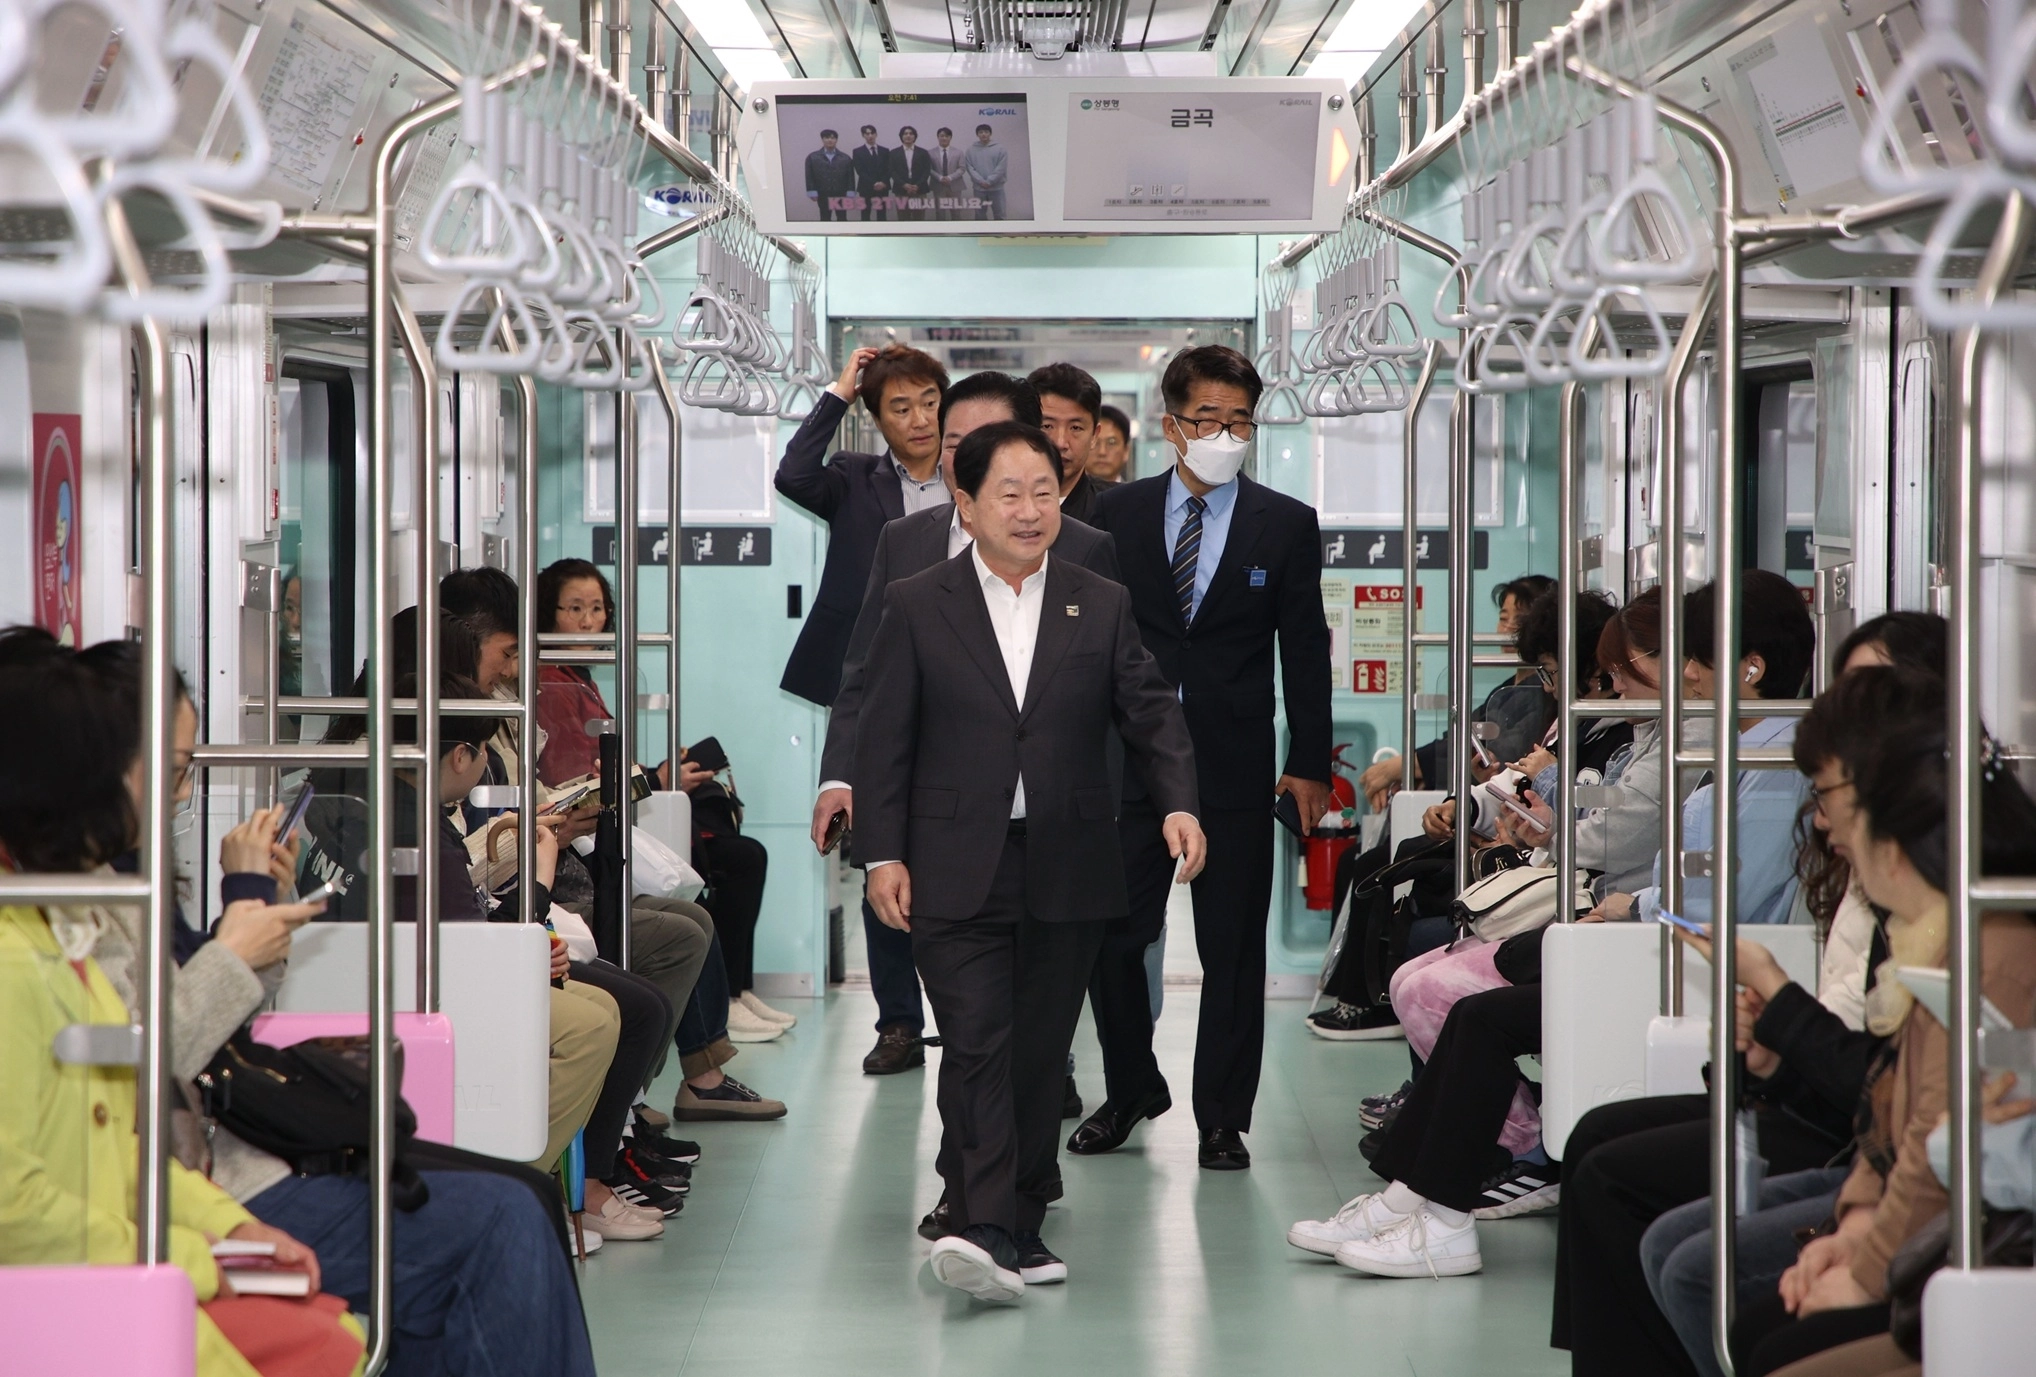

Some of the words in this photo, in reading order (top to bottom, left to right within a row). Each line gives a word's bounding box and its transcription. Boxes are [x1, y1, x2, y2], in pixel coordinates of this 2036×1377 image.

[978, 107, 1017, 117] KORAIL
[1170, 108, 1214, 128] 금곡
[828, 197, 867, 211] KBS
[1380, 588, 1404, 600] SO
